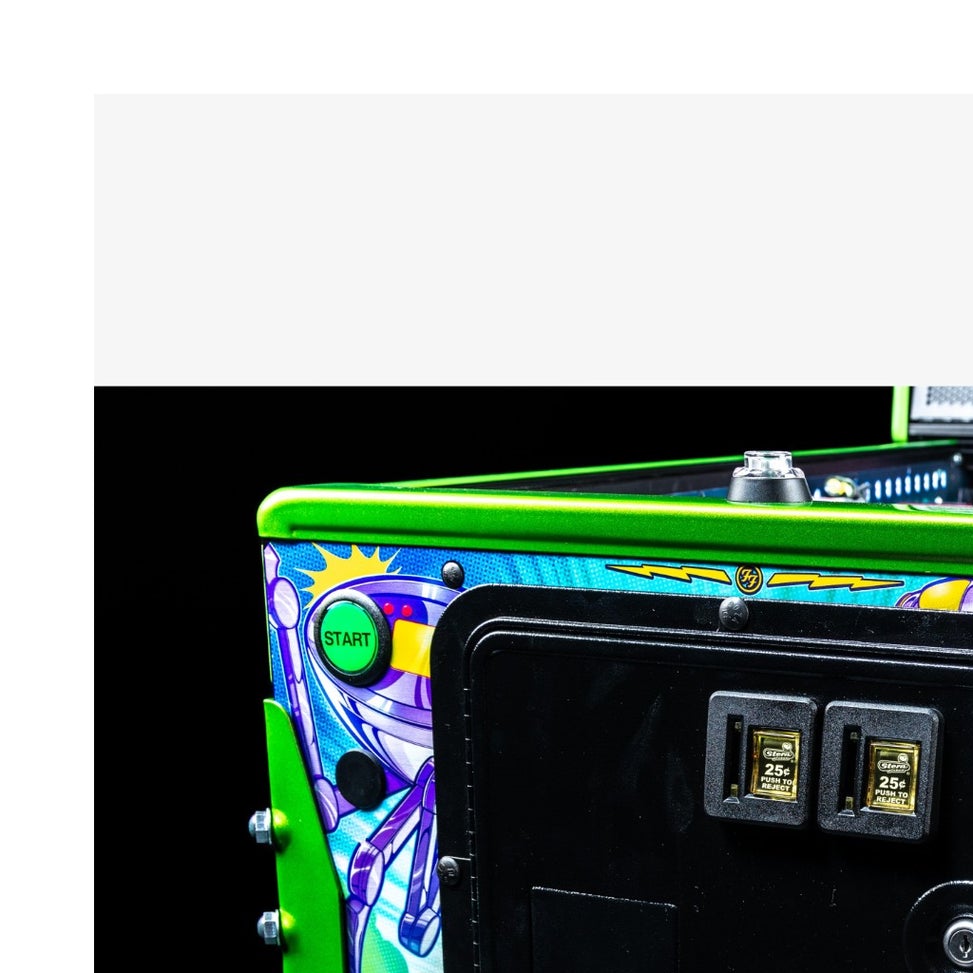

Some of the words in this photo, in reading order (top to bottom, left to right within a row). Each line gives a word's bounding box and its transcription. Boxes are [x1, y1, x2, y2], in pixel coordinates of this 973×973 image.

[324, 631, 371, 647] START
[764, 763, 791, 777] 25¢
[760, 776, 781, 784] PUSH
[783, 778, 793, 786] TO
[879, 776, 906, 790] 25¢
[761, 782, 791, 792] REJECT
[875, 789, 896, 797] PUSH
[876, 796, 906, 805] REJECT
